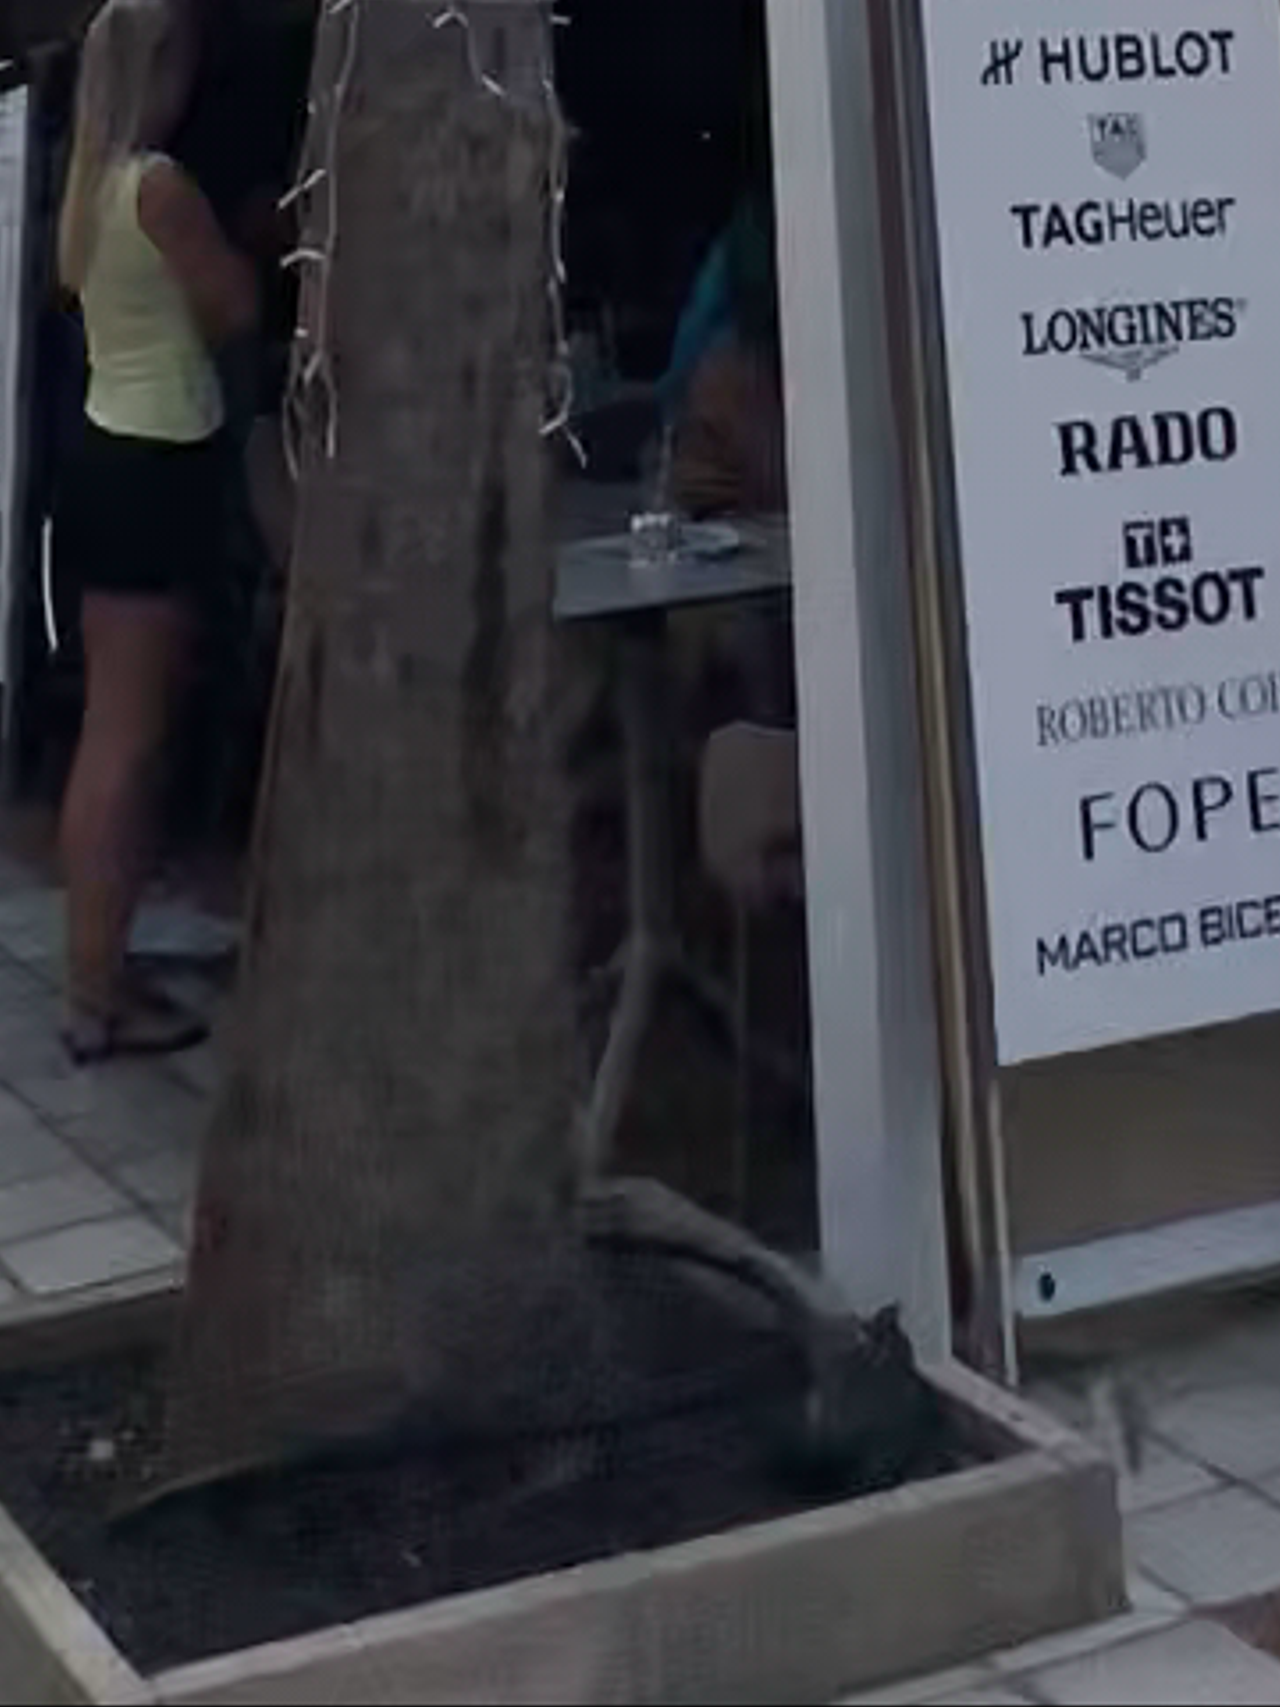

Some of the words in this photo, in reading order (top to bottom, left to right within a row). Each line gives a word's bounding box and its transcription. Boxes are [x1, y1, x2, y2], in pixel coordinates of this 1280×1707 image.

[1038, 30, 1236, 84] HUBLOT
[1021, 297, 1241, 355] LONGINES
[1056, 406, 1238, 477] RADO
[1054, 567, 1266, 642] TISSOT
[1035, 683, 1206, 747] ROBERTO
[1035, 913, 1188, 977] MARCO
